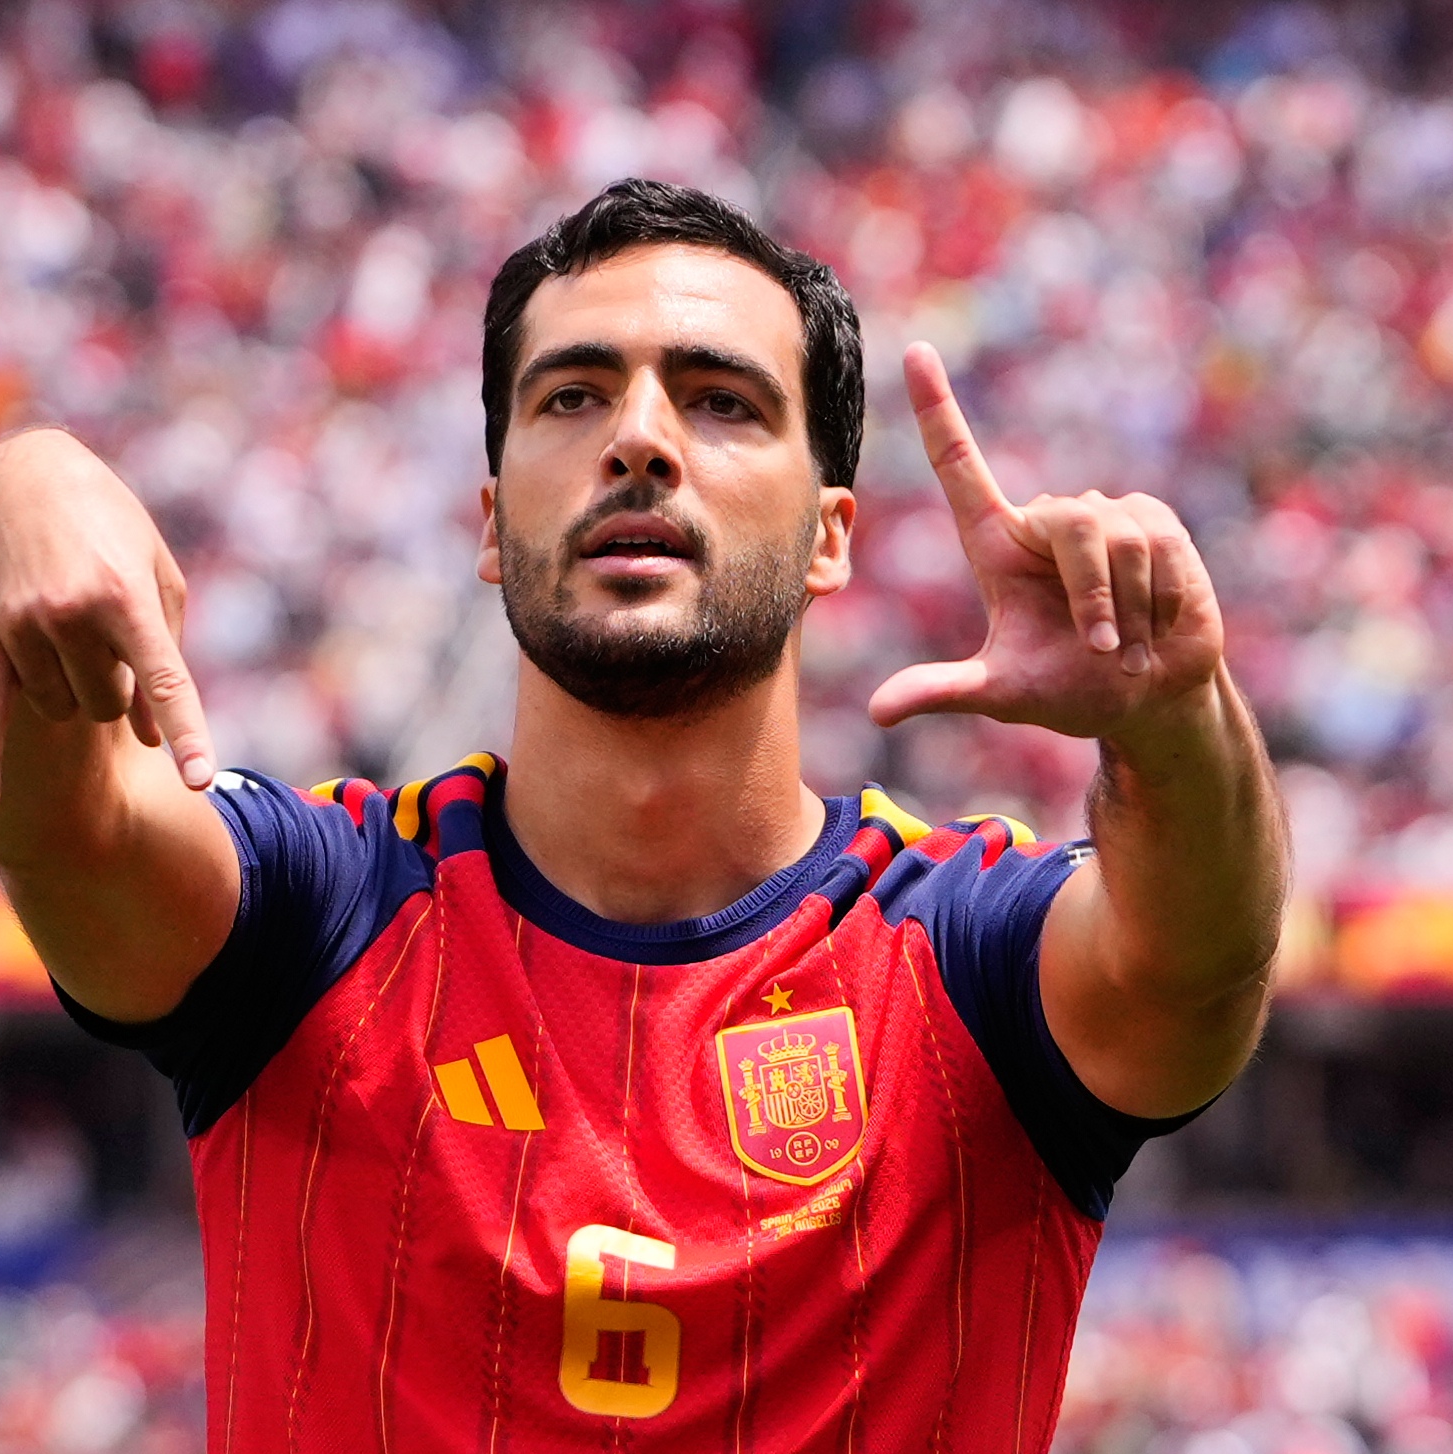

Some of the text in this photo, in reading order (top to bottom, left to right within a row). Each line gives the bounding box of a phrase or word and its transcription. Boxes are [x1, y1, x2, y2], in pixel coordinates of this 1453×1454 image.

[793, 1138, 813, 1150] RF
[824, 1138, 840, 1150] 09
[769, 1147, 783, 1159] 19
[794, 1148, 815, 1159] EF
[810, 1195, 841, 1213] 2026
[760, 1213, 793, 1231] SPAIN
[794, 1212, 842, 1232] ANGELES
[558, 1223, 682, 1420] 6
